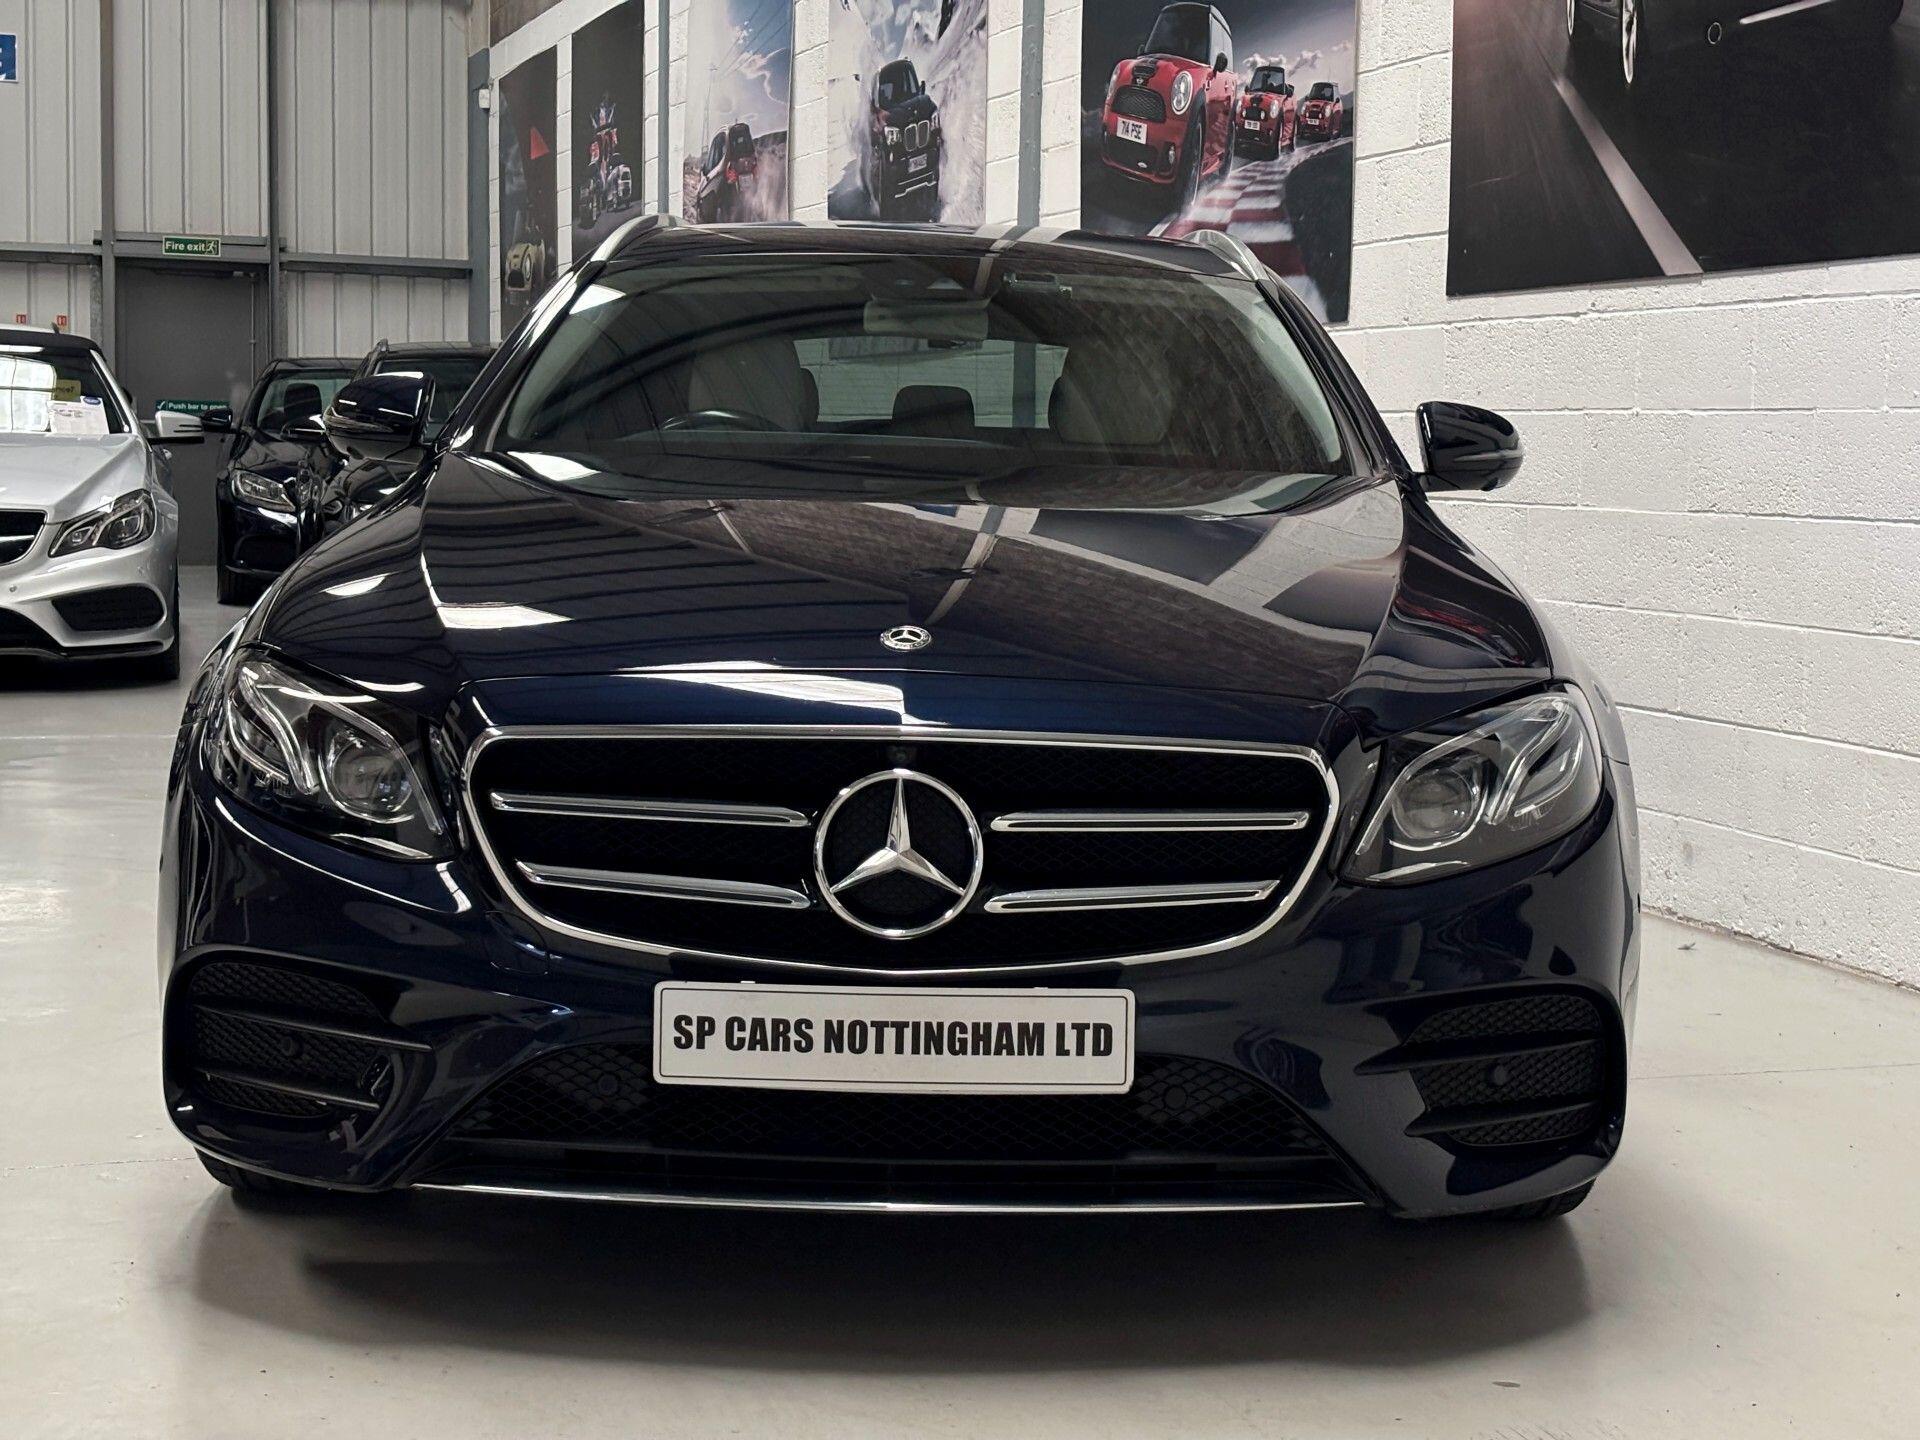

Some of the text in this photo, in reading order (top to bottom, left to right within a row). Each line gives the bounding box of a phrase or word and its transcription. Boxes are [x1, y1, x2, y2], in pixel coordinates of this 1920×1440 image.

[165, 241, 206, 252] Fire exit
[168, 402, 187, 410] Push
[673, 1014, 1113, 1057] SP CARS NOTTINGHAM LTD
